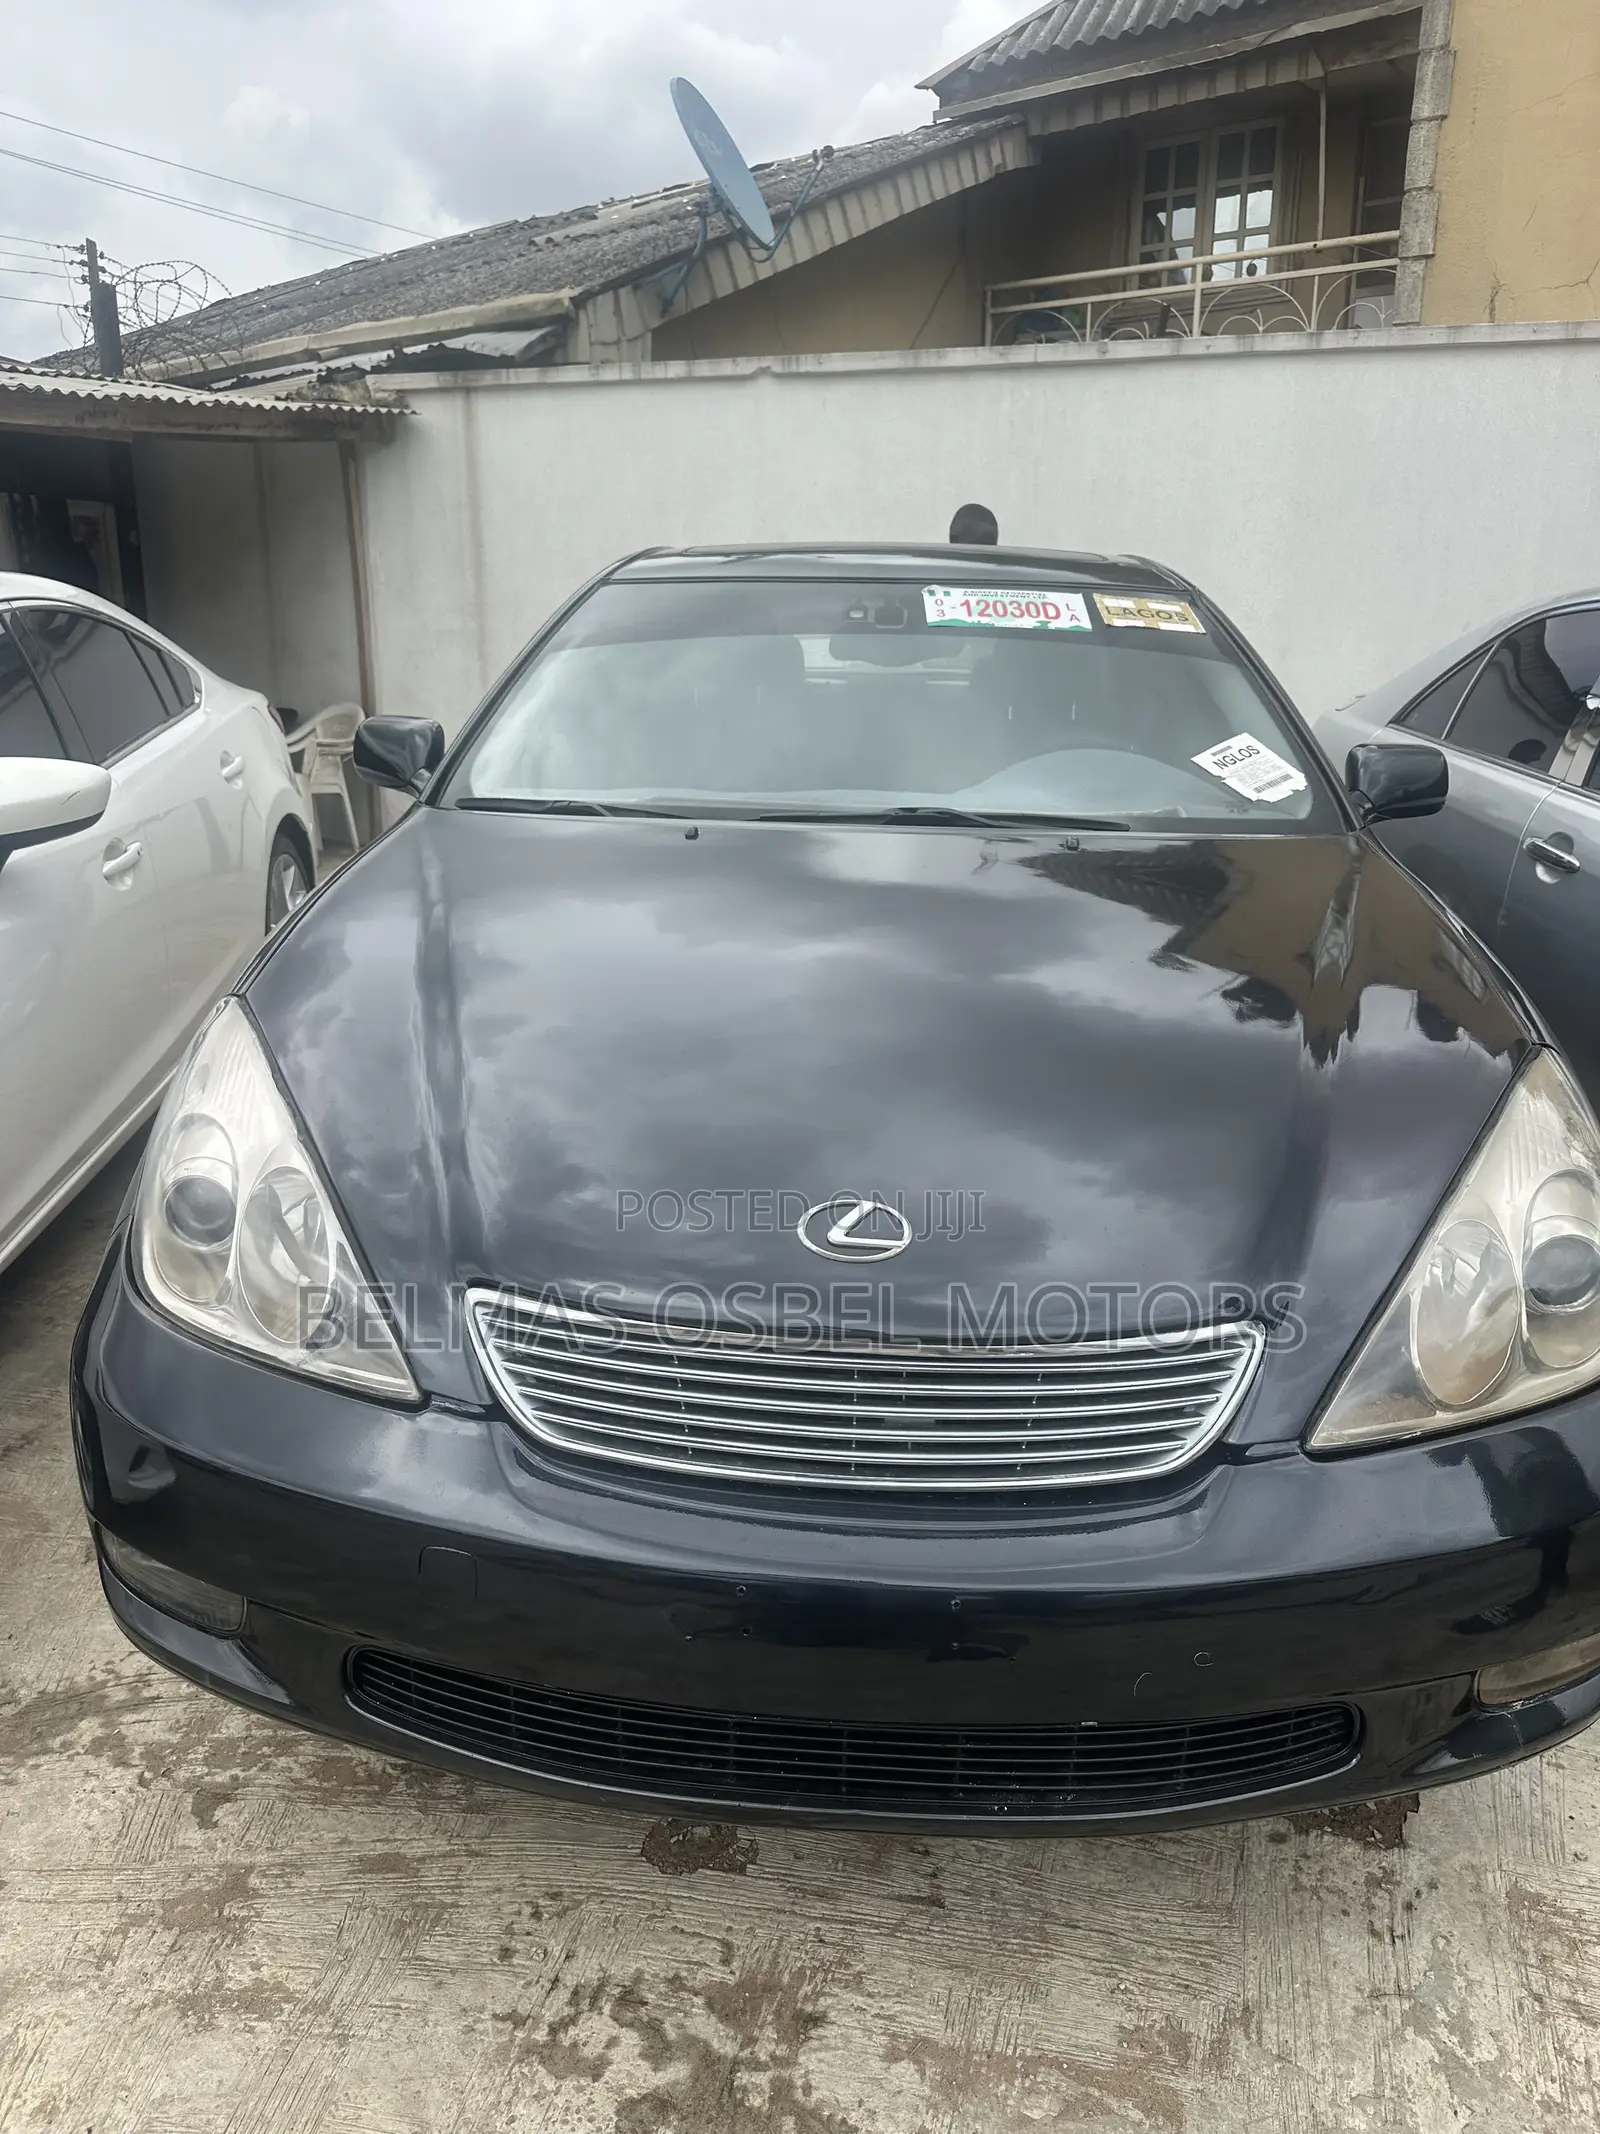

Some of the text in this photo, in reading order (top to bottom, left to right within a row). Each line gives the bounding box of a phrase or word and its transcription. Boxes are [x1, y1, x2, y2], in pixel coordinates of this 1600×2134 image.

[960, 598, 1062, 621] 12030D
[1105, 606, 1190, 622] LAGOS
[1212, 745, 1261, 770] NGLOS
